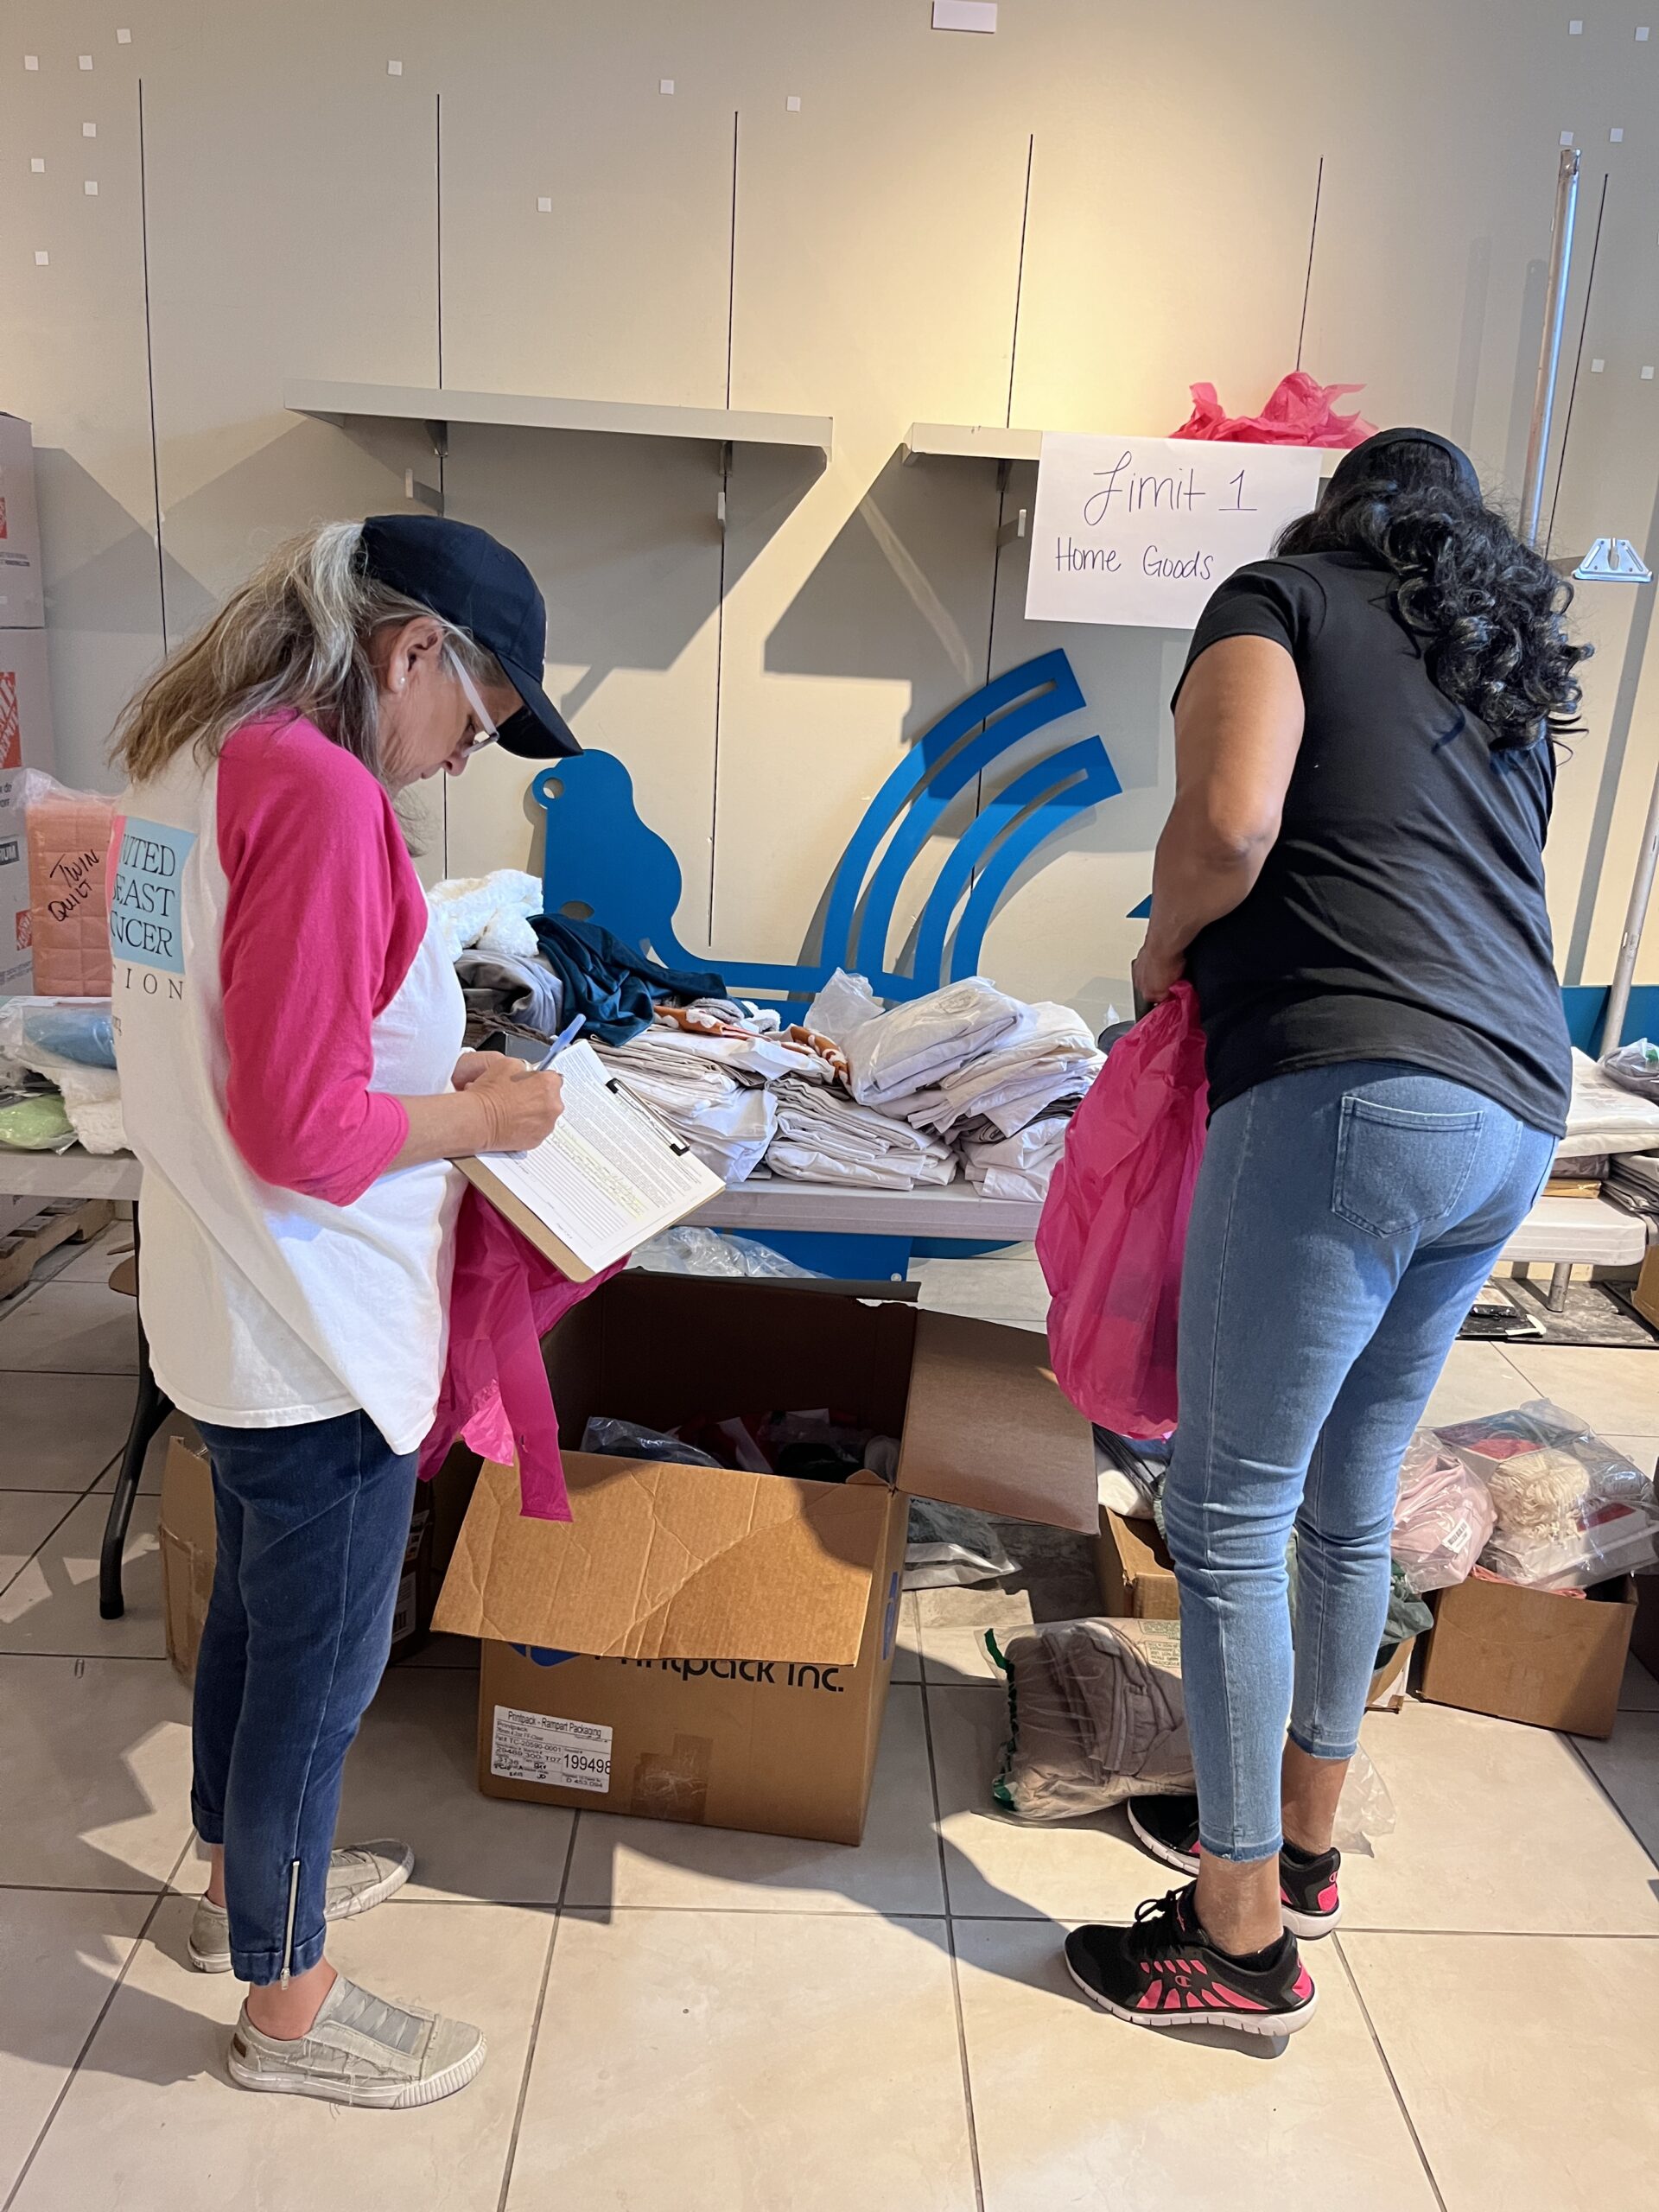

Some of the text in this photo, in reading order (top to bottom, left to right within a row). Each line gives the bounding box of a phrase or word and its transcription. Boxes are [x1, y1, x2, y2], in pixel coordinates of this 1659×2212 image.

[1084, 450, 1257, 526] Limit 1
[1055, 537, 1213, 580] Home Goods
[49, 849, 100, 889] TWIN
[48, 882, 93, 923] QUILT
[112, 874, 175, 917] EAST
[110, 910, 174, 957] NCER
[124, 967, 184, 1001] ION
[508, 1711, 536, 1726] Printpack
[569, 1722, 602, 1738] Packaging
[563, 1753, 612, 1775] 199498
